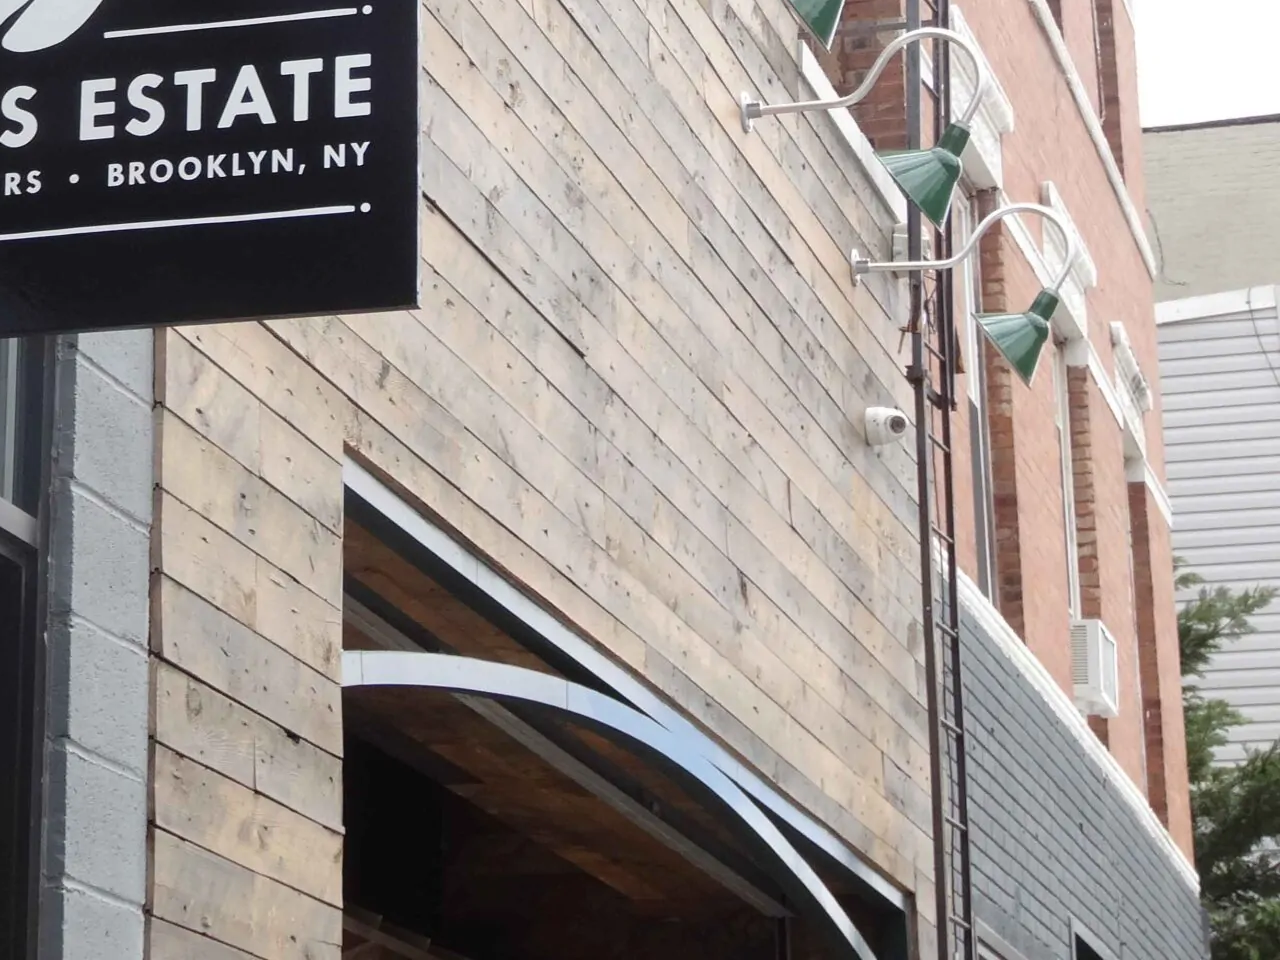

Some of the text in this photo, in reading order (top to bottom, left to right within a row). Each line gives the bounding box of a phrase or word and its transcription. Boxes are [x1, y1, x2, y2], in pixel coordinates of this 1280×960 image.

[80, 53, 371, 140] ESTATE
[108, 148, 305, 186] BROOKLYN,
[324, 142, 370, 168] NY
